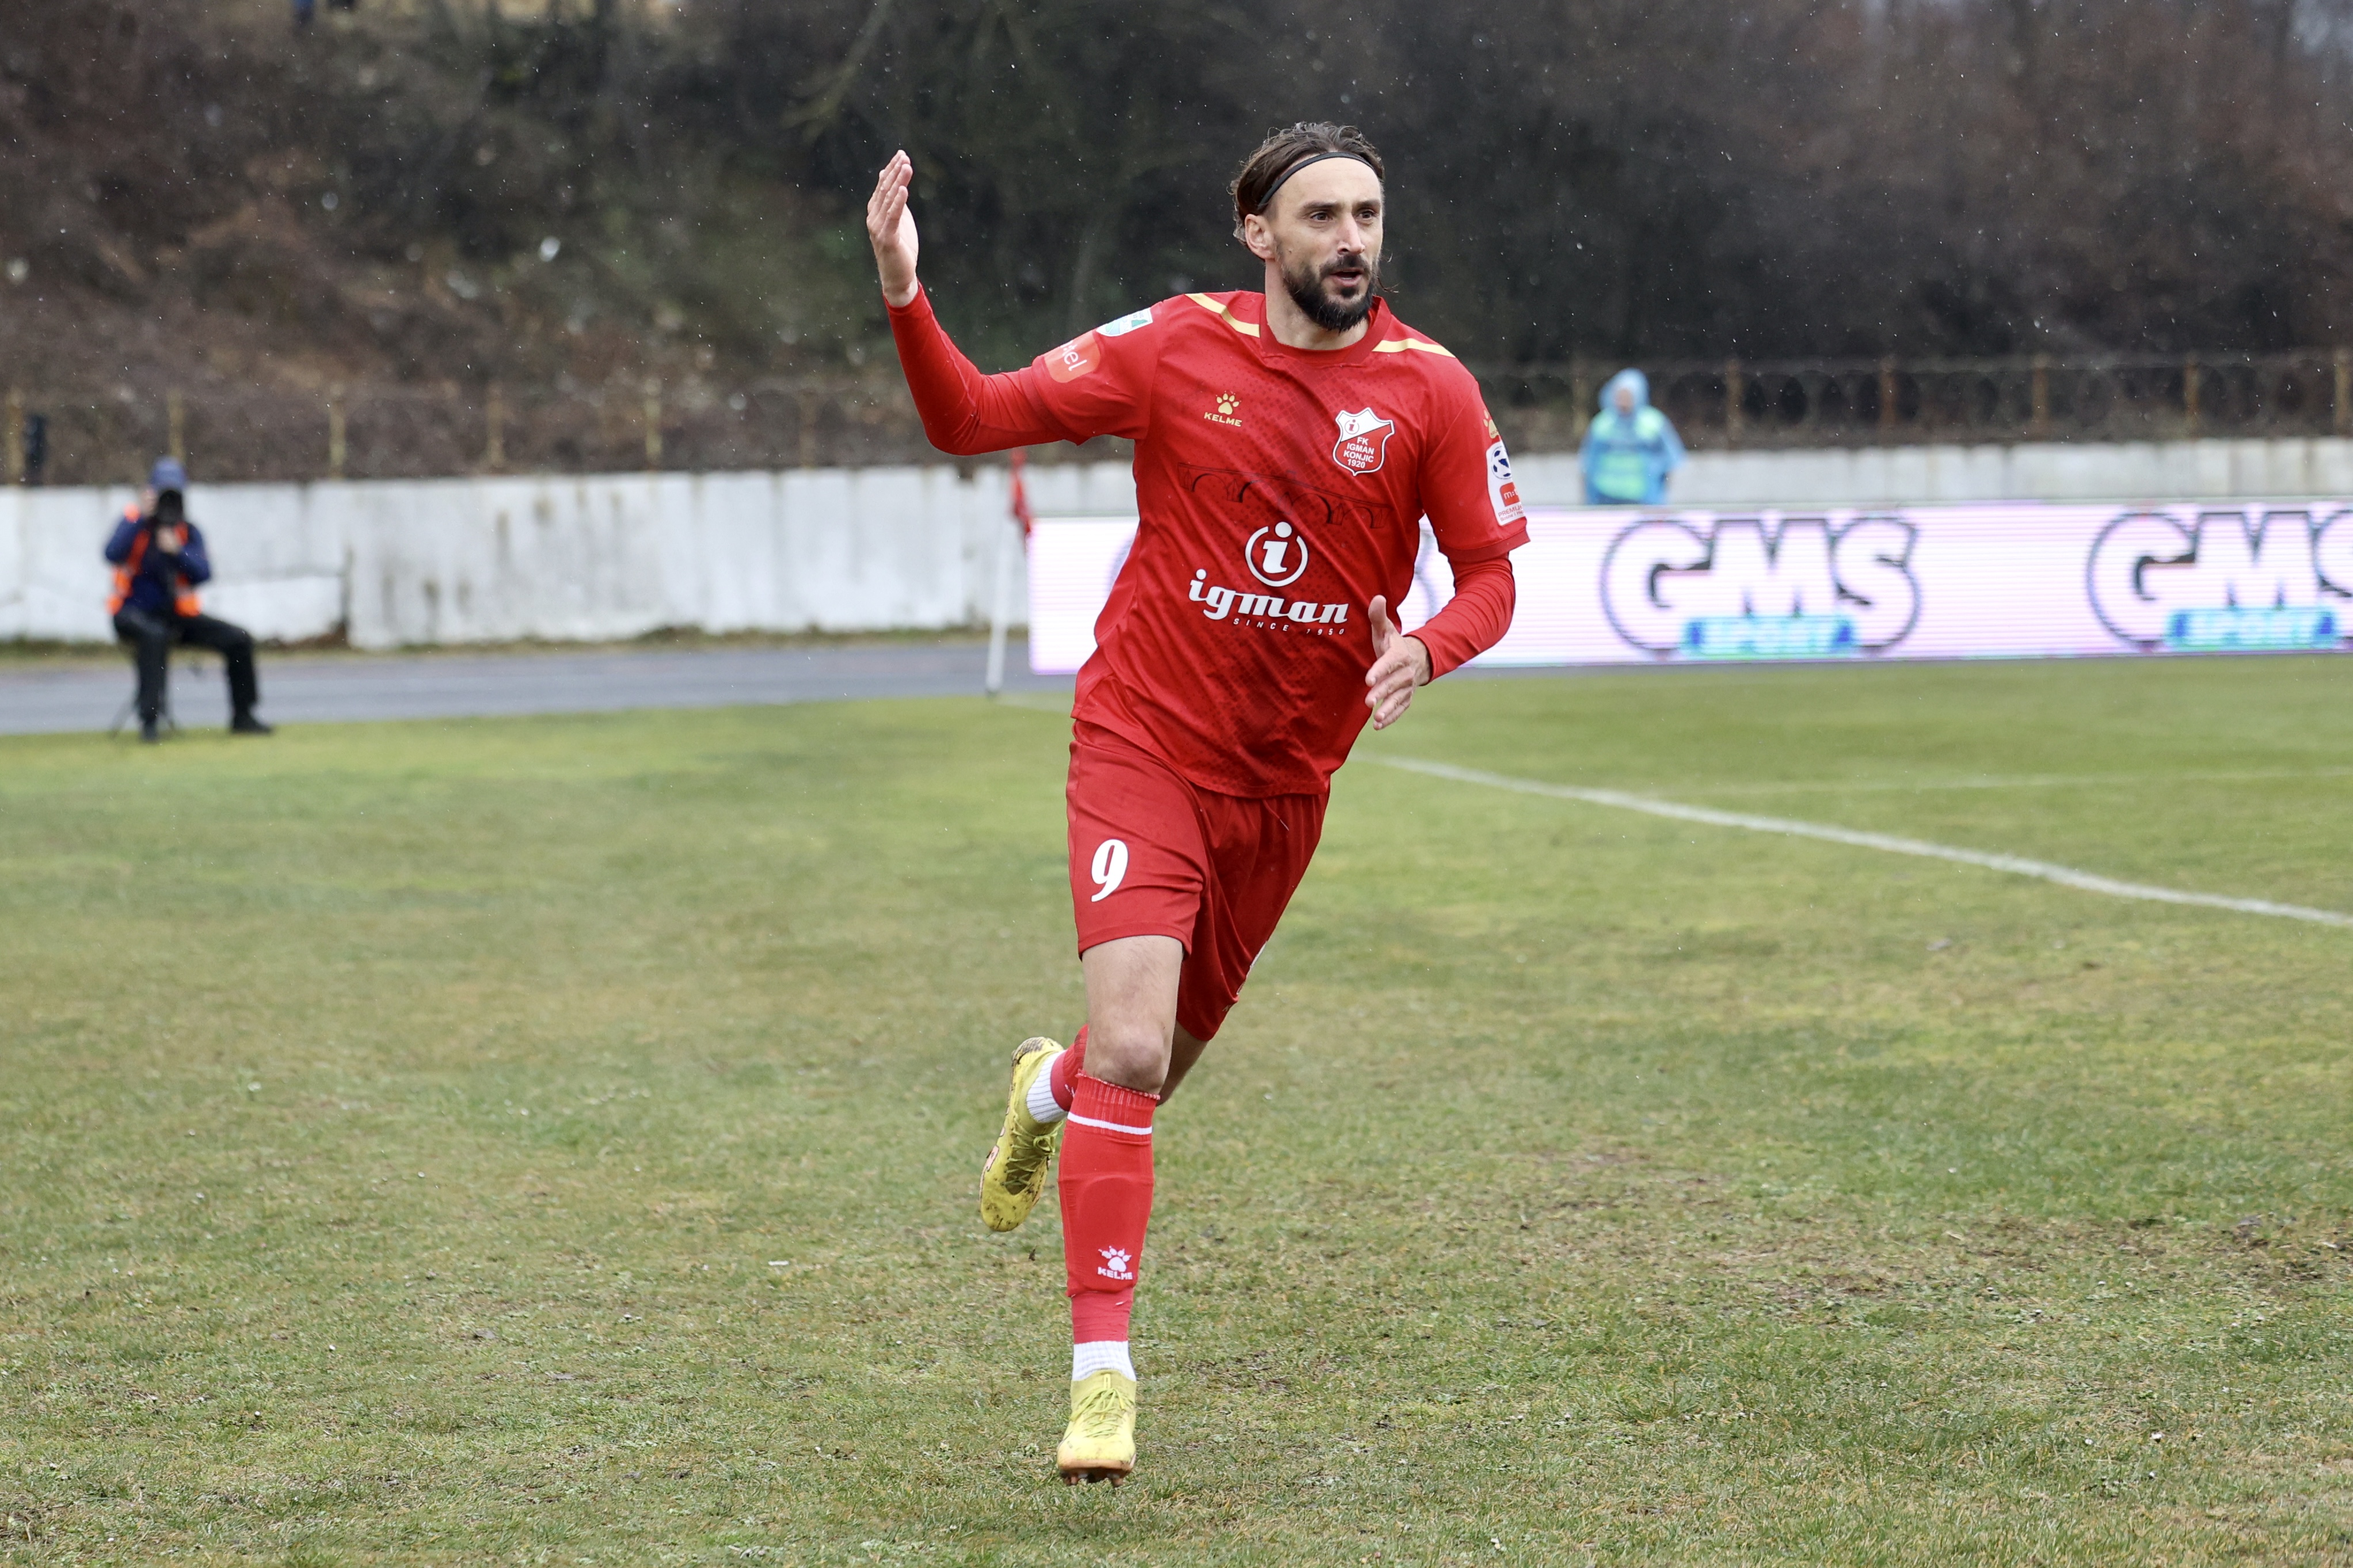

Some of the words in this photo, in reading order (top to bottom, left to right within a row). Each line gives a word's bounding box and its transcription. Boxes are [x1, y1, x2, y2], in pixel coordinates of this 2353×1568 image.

[1060, 340, 1087, 371] :tel
[1204, 412, 1242, 427] KELME
[1357, 437, 1369, 445] FK
[1347, 442, 1375, 455] IGMAN
[1343, 450, 1374, 463] KONJIC
[1347, 459, 1365, 468] 1920
[1600, 517, 1922, 650] GMS
[1189, 569, 1349, 624] igman
[1233, 618, 1289, 631] SINCE
[1091, 838, 1128, 902] 9
[1097, 1266, 1133, 1280] KELME
